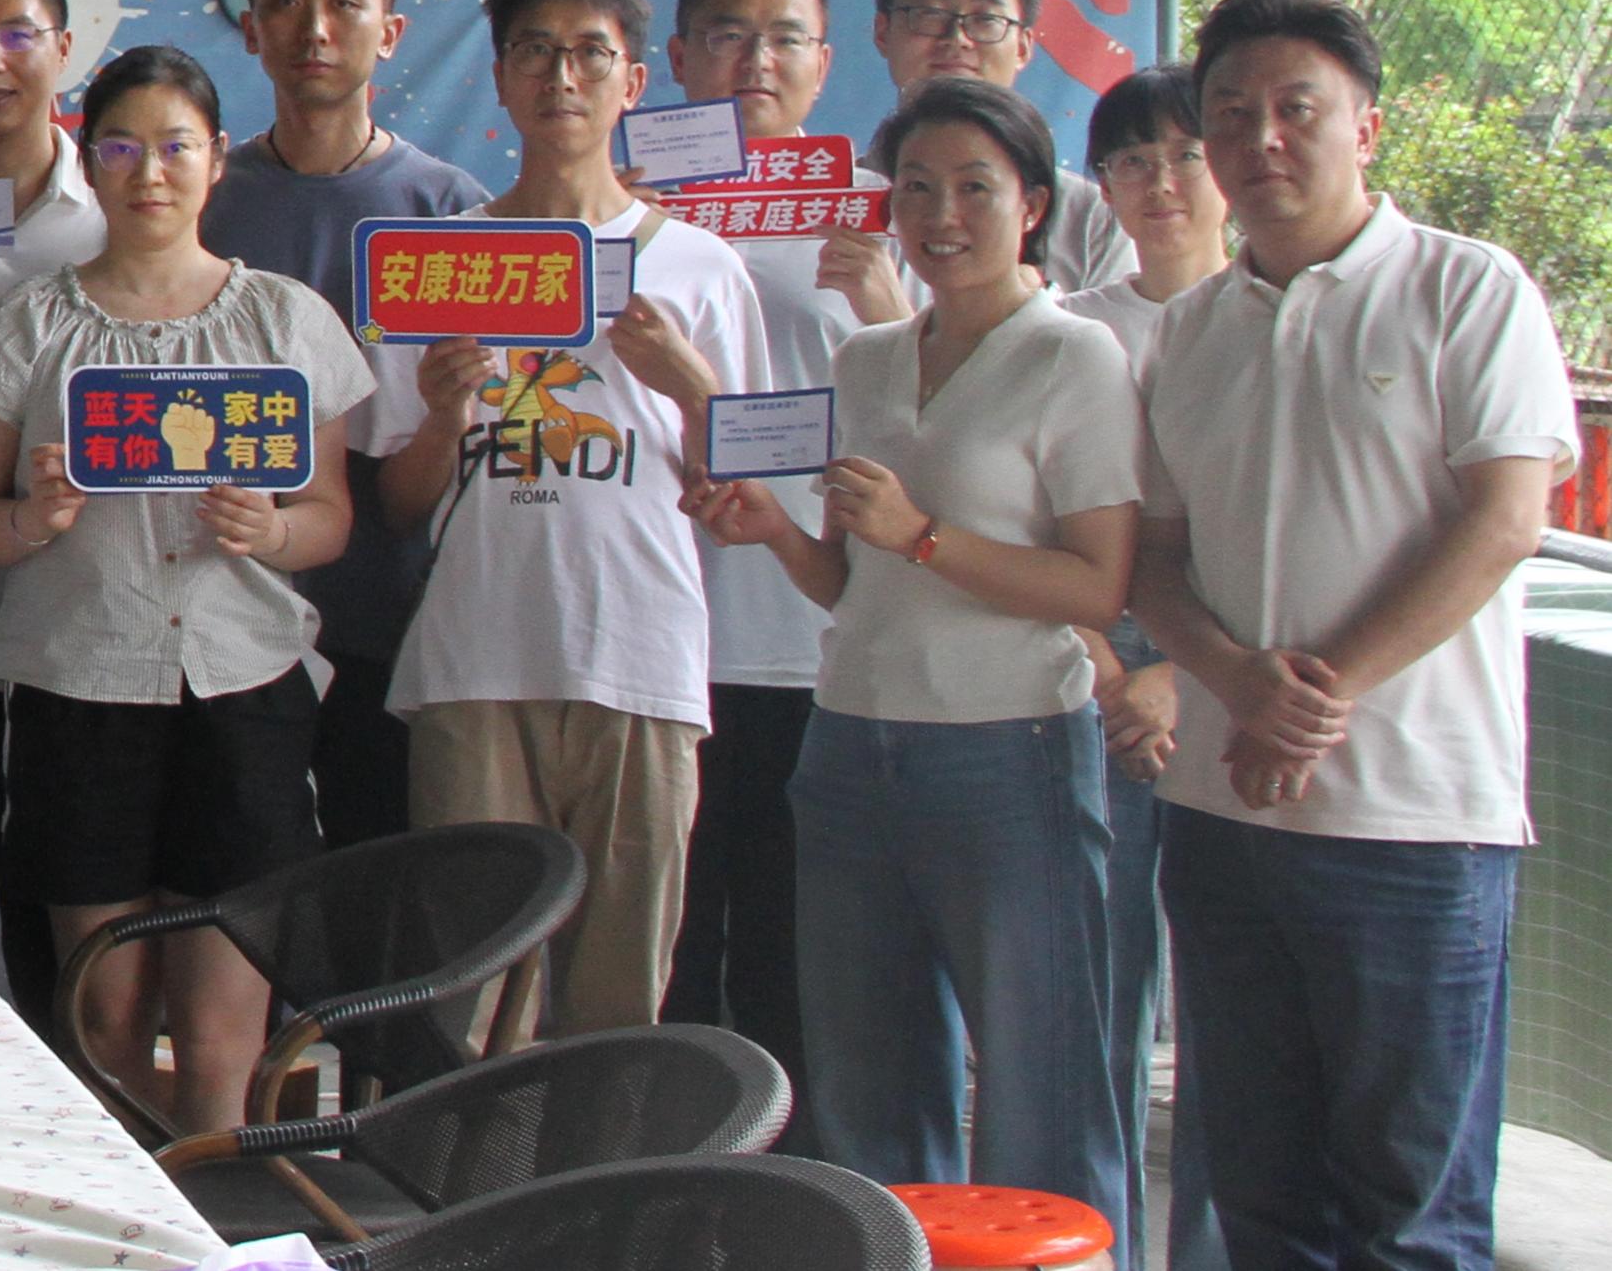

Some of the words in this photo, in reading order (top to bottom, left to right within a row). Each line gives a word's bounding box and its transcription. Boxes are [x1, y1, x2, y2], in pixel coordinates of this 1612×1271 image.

[378, 250, 574, 307] 安康进万家
[149, 371, 230, 382] LANTIANYOUNI
[83, 390, 159, 427] 蓝天
[222, 390, 297, 427] 家中
[83, 433, 160, 470] 有你
[222, 433, 298, 470] 有爱
[458, 418, 636, 487] FENDI
[145, 474, 232, 485] JIAZHONGYOUAI
[509, 489, 560, 506] ROMA
